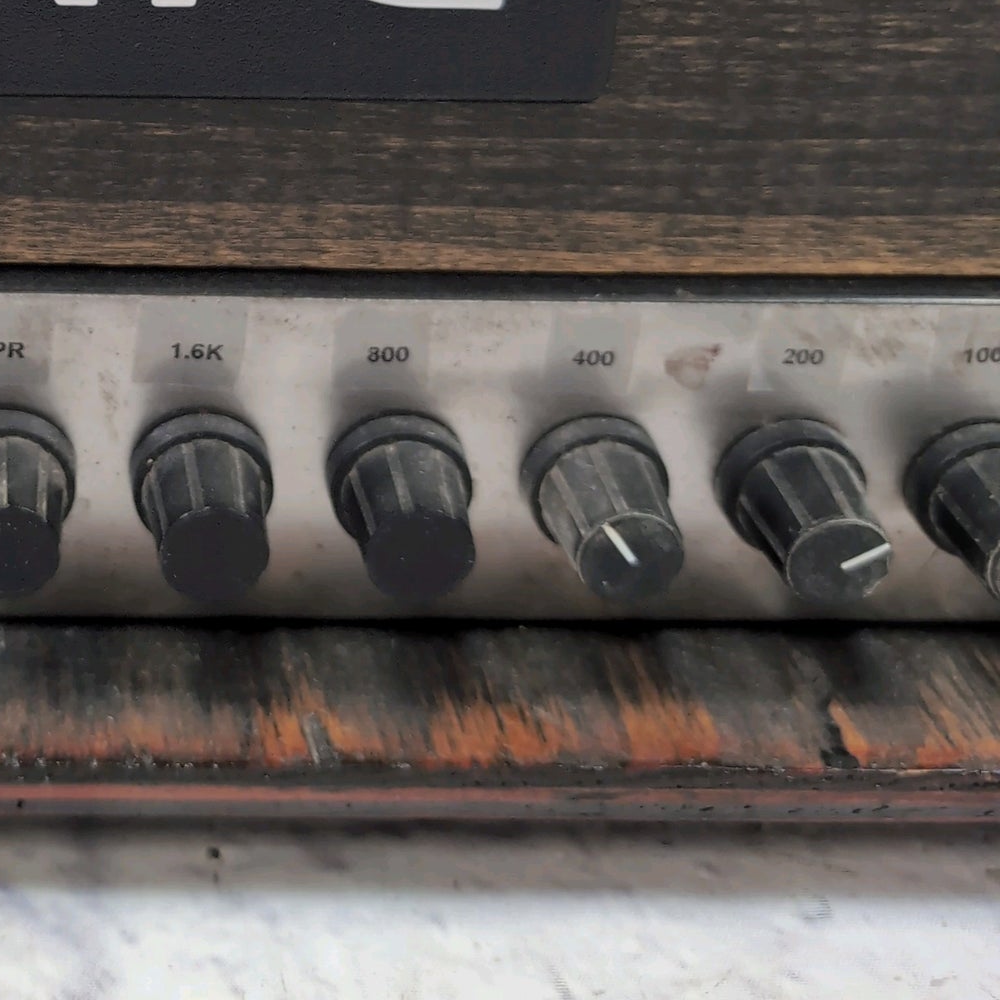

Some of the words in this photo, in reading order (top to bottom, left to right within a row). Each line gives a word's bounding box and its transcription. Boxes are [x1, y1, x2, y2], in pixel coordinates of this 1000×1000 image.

[171, 342, 224, 362] 1.6K
[367, 345, 409, 362] 800
[571, 350, 616, 367] 400
[782, 348, 825, 366] 200
